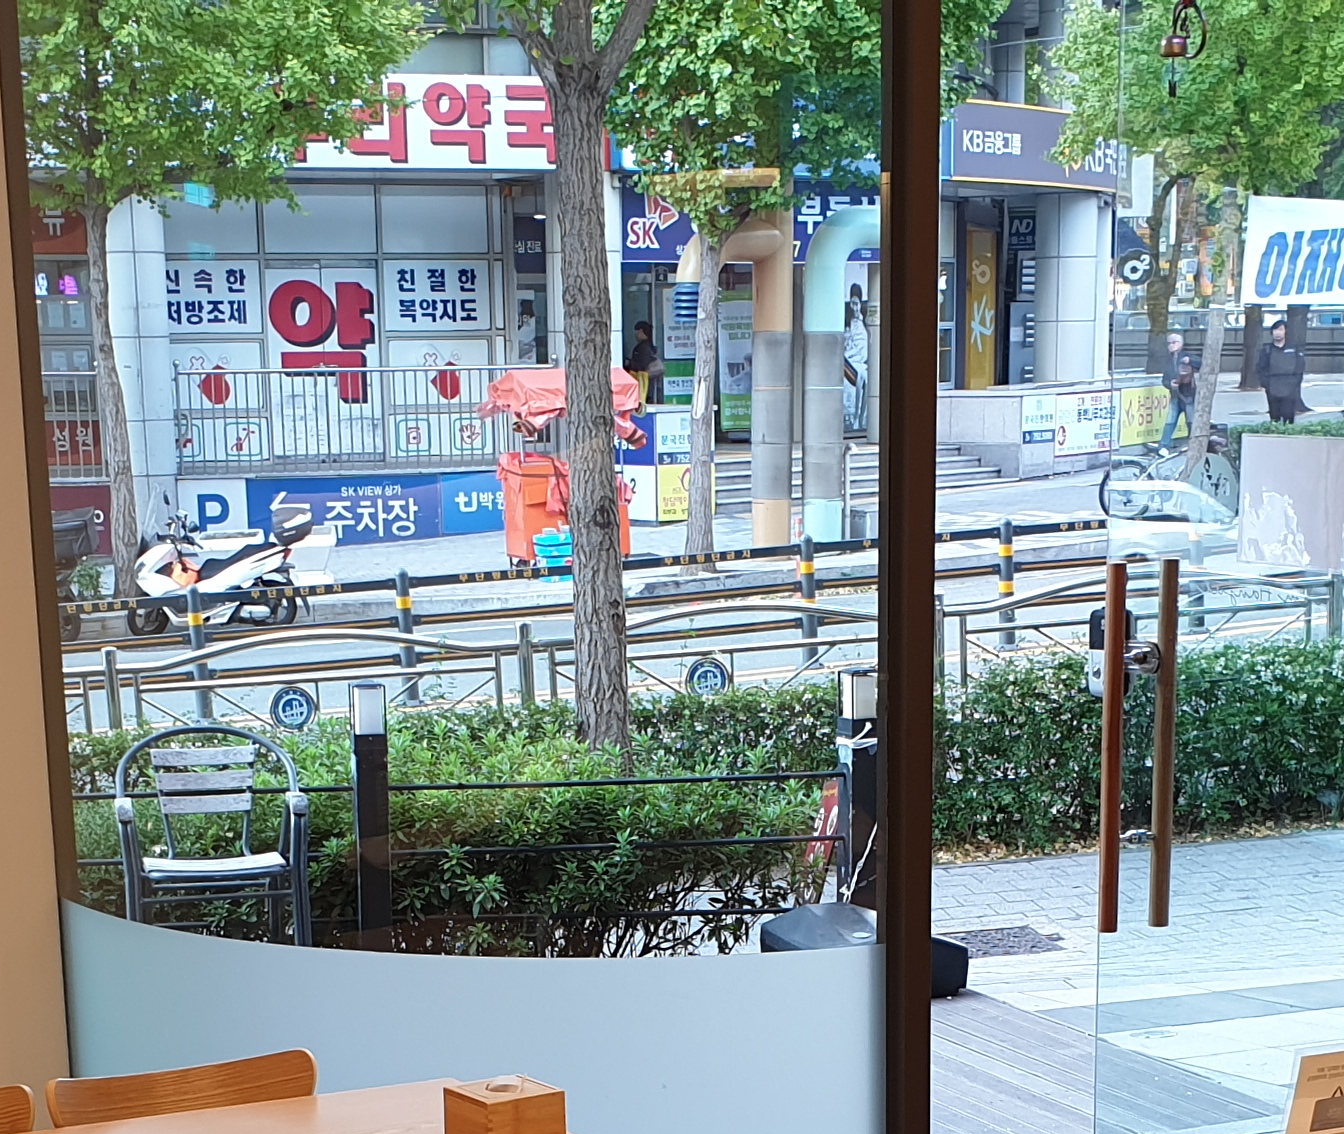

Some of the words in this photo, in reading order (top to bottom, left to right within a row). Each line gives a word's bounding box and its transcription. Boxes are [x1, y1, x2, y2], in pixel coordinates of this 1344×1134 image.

[962, 129, 1022, 156] KB금융그룹
[627, 217, 659, 248] SK
[396, 268, 477, 293] 친절한
[398, 298, 478, 323] 복약지도
[268, 279, 375, 404] 약
[341, 487, 356, 497] SK
[357, 485, 383, 497] VIEW
[196, 493, 230, 532] P
[323, 497, 419, 539] 주차장
